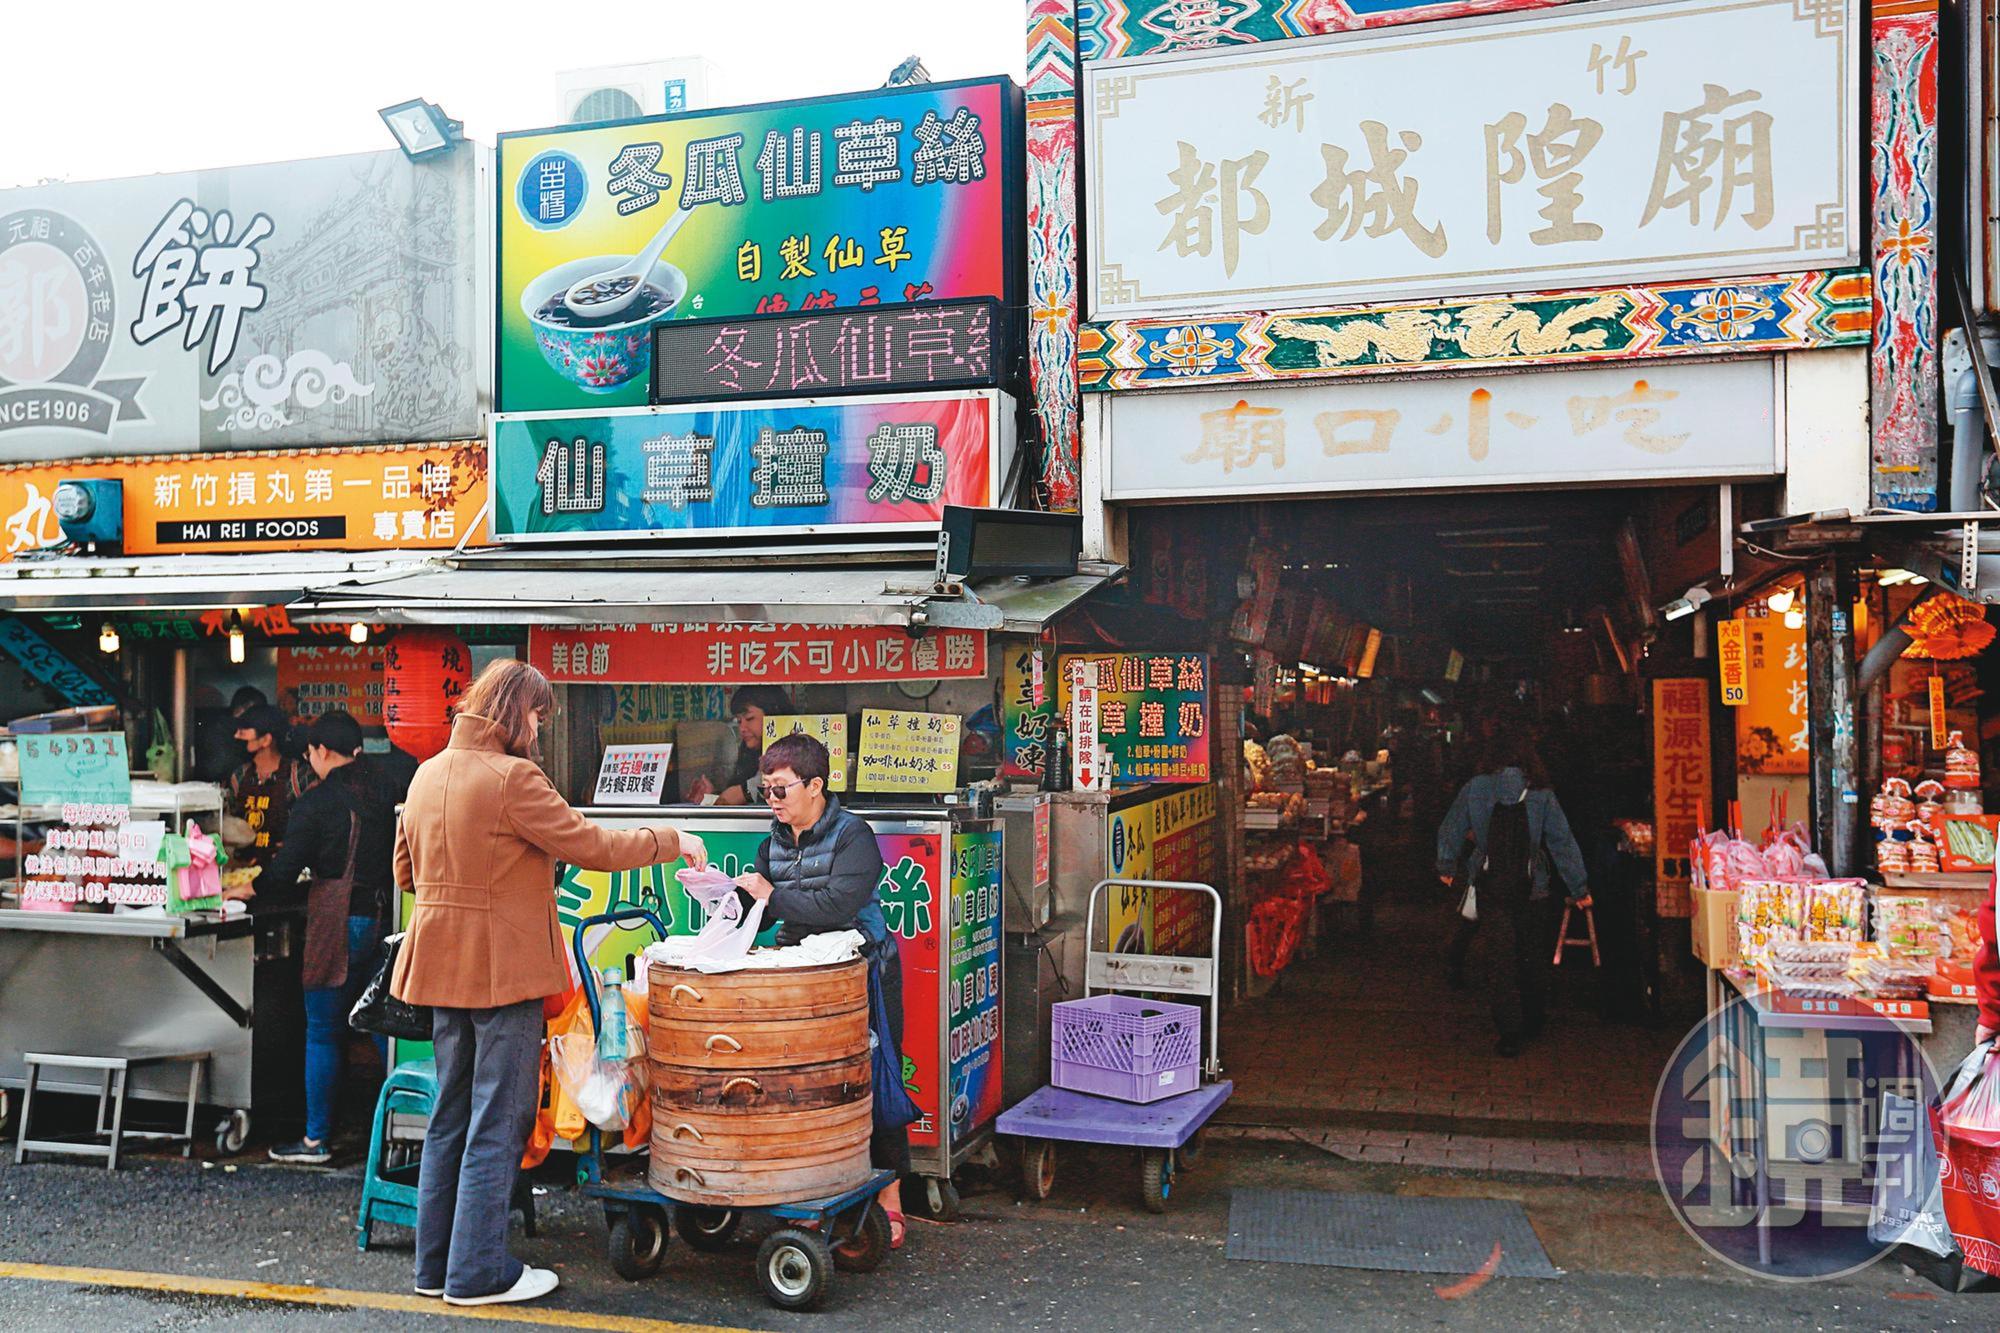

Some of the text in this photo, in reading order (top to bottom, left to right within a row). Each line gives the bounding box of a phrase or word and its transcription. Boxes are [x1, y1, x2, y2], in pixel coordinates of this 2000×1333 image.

[607, 106, 987, 217] 冬瓜仙草絲
[1155, 84, 1776, 279] 都城隍廟
[736, 226, 912, 282] 自製仙草
[130, 198, 274, 376] 餅
[1180, 378, 1696, 475] 廟口小吃
[535, 424, 945, 516] 仙草撞奶
[183, 520, 319, 540] HAI REI FOODS
[373, 510, 456, 541] 專賣店
[552, 635, 976, 676] 美食節 非吃不可小吃優勝
[1726, 687, 1744, 701] 50
[832, 722, 842, 731] 40
[867, 715, 941, 732] 仙草撞奶
[832, 748, 842, 756] 40
[598, 776, 655, 793] 點餐取餐
[832, 772, 842, 781] 40
